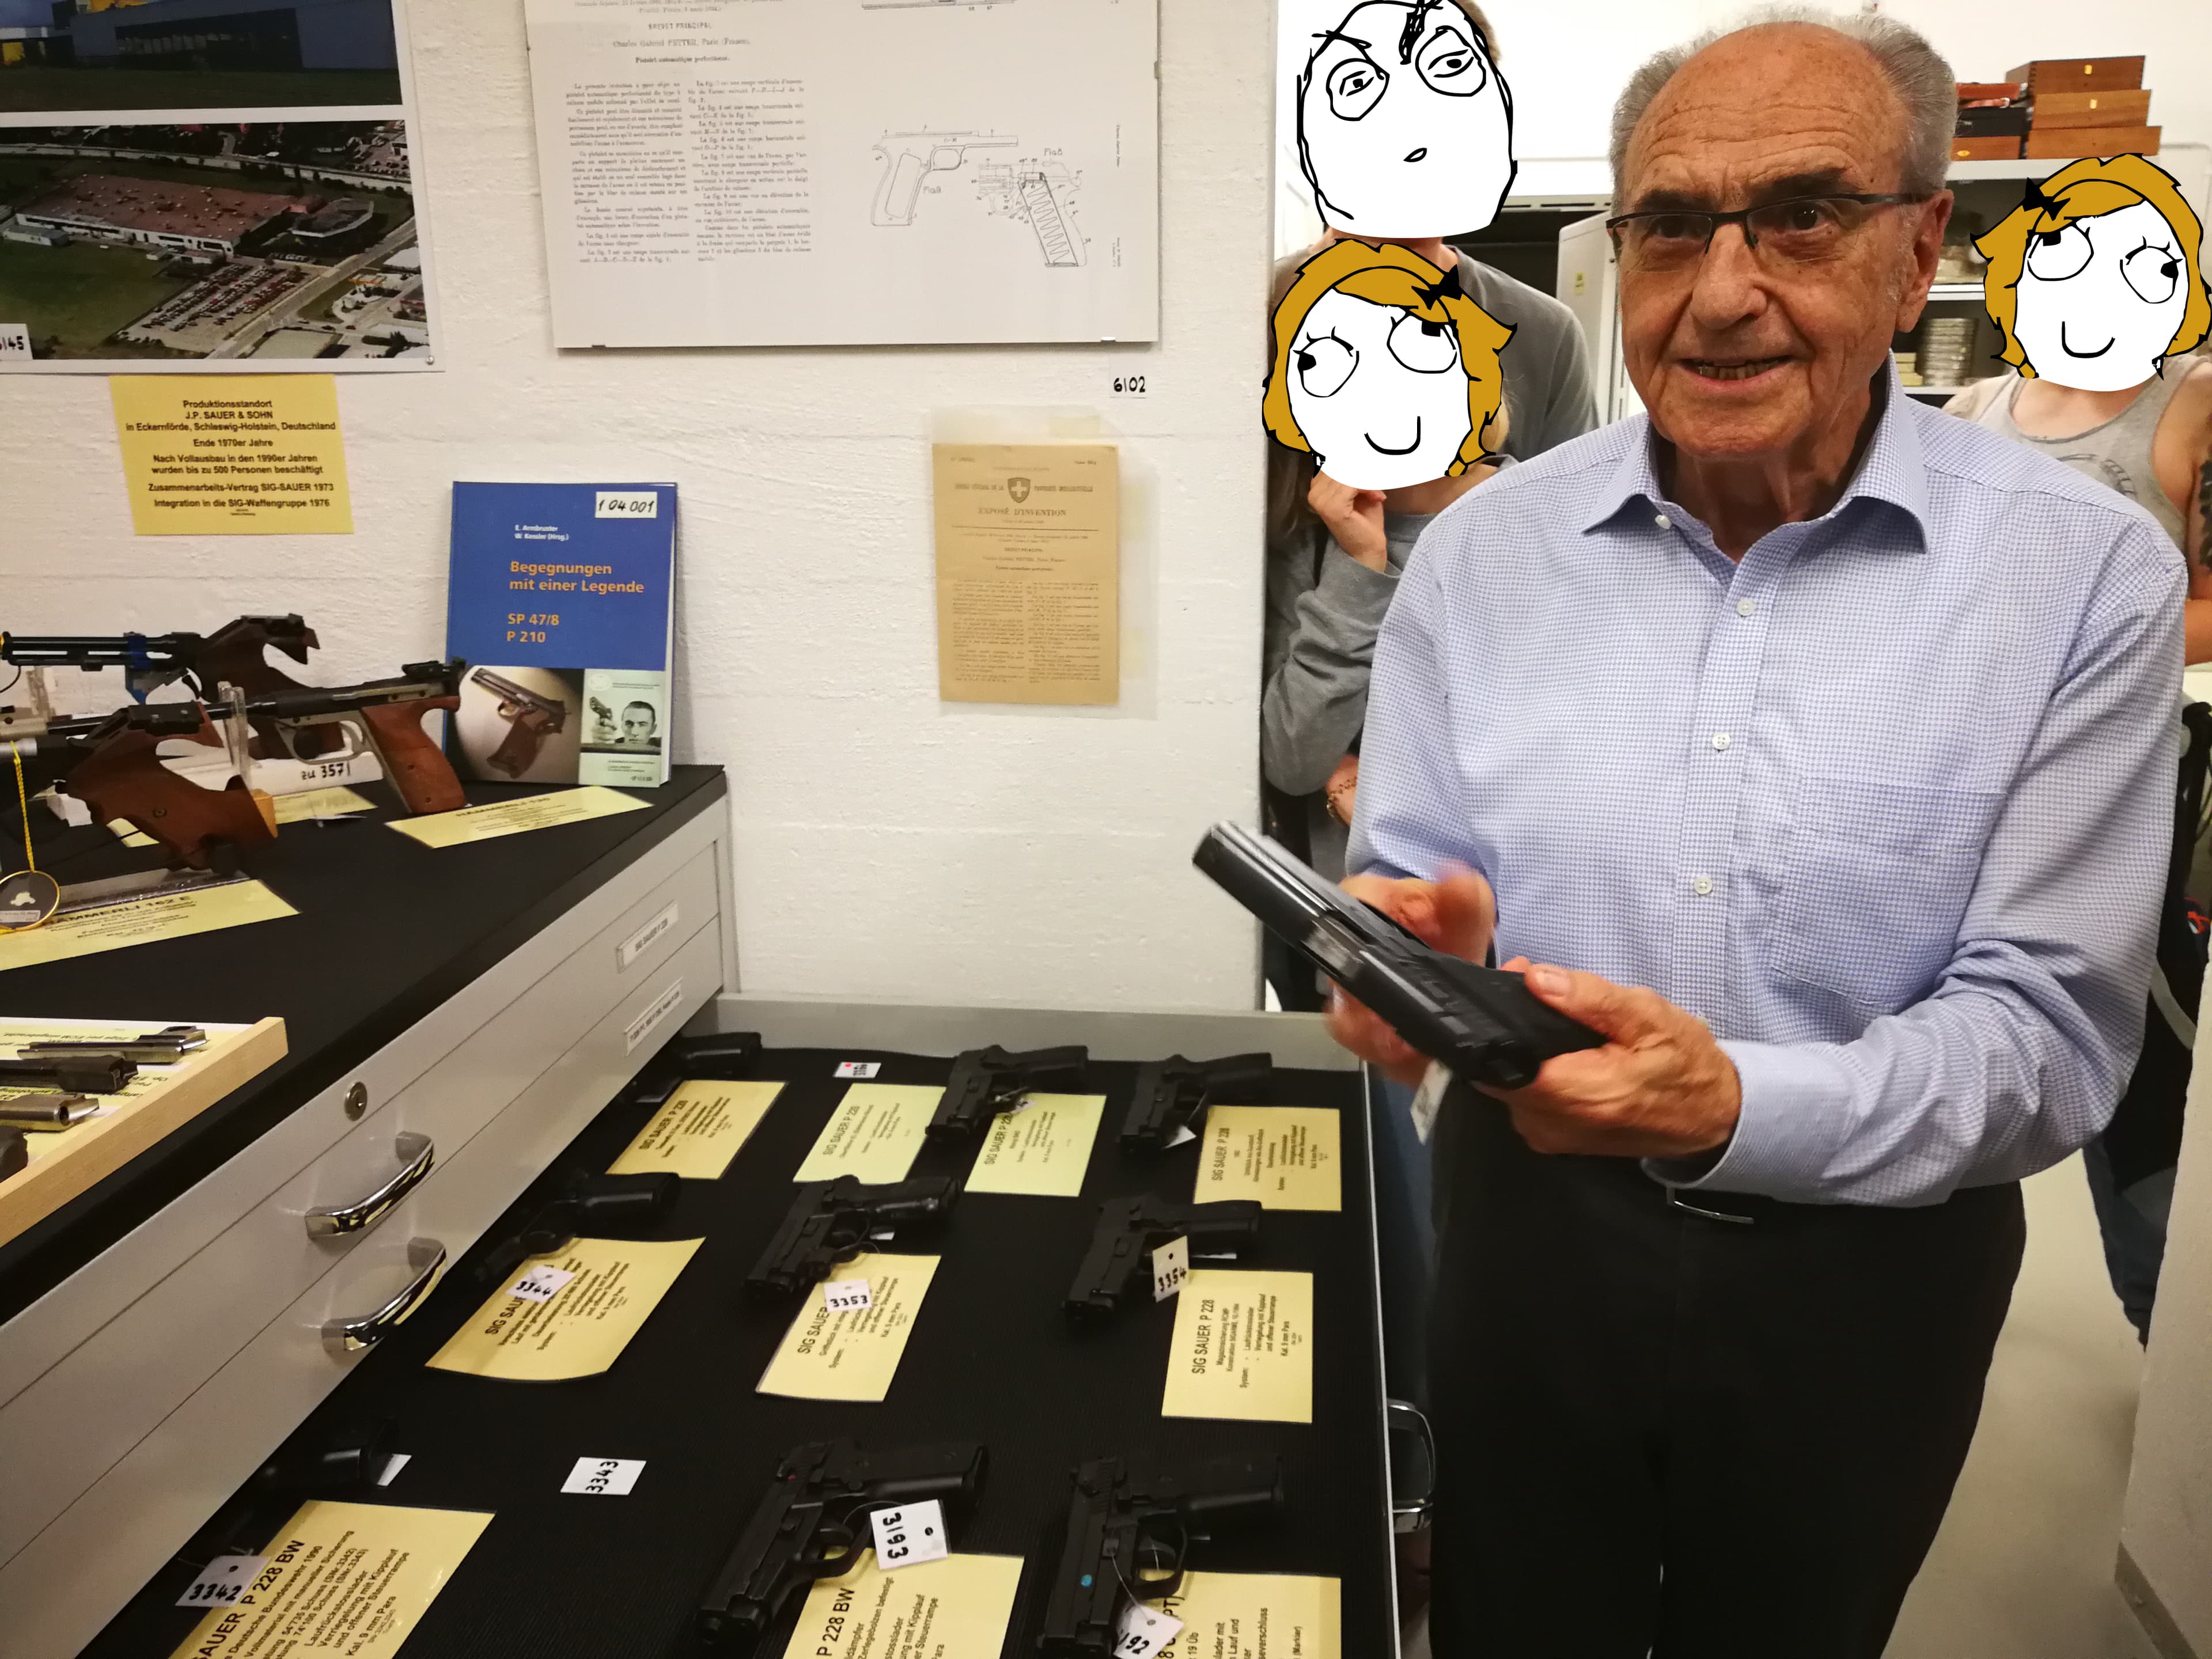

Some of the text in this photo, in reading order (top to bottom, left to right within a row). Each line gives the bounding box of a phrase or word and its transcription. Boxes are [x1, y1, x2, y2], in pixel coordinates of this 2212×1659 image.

[1113, 376, 1146, 394] 6102
[183, 400, 272, 408] Produktionsstandort
[185, 411, 274, 419] J.P. SAUER & SOHN
[137, 423, 192, 432] Eckernförde,
[194, 422, 280, 433] Schleswig-Holstein,
[281, 422, 336, 430] Deutschland
[194, 438, 274, 447] Ende 1970er Jahre
[153, 454, 176, 463] Nach
[177, 454, 226, 463] Vollausbau
[238, 454, 254, 462] den
[257, 454, 286, 462] 1990er
[288, 453, 318, 462] Jahren
[152, 466, 184, 474] wurden
[186, 465, 199, 474] bis
[214, 465, 229, 474] 500
[231, 465, 272, 474] Personen
[274, 465, 323, 476] beschäftigt
[148, 483, 334, 493] Zusammenarbeits-Vertrag SIG-SAUER 1973
[154, 499, 200, 508] Integration
[213, 499, 226, 507] die
[229, 499, 308, 509] SIG-Waffengruppe
[598, 499, 654, 513] 1 04 001
[510, 560, 612, 577] Begegnungen
[509, 578, 645, 595] mit einer Legende
[507, 613, 560, 626] SP 47/8
[507, 631, 546, 643] P 210
[648, 1117, 673, 1137] SAUER
[1213, 1146, 1227, 1168] SAUER
[1211, 1169, 1223, 1180] SIG
[1157, 1266, 1187, 1292] 3354
[516, 1281, 552, 1297] 3344
[830, 1295, 869, 1308] 3353
[1200, 1299, 1214, 1312] 228
[483, 1320, 507, 1334] SIG
[797, 1338, 816, 1353] SIG
[1194, 1324, 1211, 1355] SAUER
[1191, 1358, 1207, 1374] SIG
[585, 1461, 619, 1493] 3343
[882, 1512, 909, 1559] 3193
[240, 1540, 306, 1604] P 228 BW
[189, 1584, 243, 1601] 3342
[227, 1546, 323, 1653] Deutsche Bundeswehr 1990
[244, 1531, 355, 1657] Vollmaterial mit manueller Sicherung
[300, 1585, 328, 1610] Schuss
[312, 1585, 339, 1611] Schuss
[318, 1548, 400, 1647] Verriegelung mit Kipplauf
[331, 1552, 411, 1647] und offener Steuerrampe
[305, 1570, 369, 1646] Laufrückstosslader
[903, 1593, 929, 1627] Kipplauf
[344, 1640, 365, 1656] Kal.
[364, 1616, 382, 1630] mm
[376, 1596, 396, 1613] Para
[815, 1587, 858, 1656] P 228 BW
[913, 1598, 941, 1647] Steuerrampe
[1216, 1622, 1225, 1635] mit
[902, 1630, 916, 1642] mit
[1228, 1618, 1240, 1654] Lauf und
